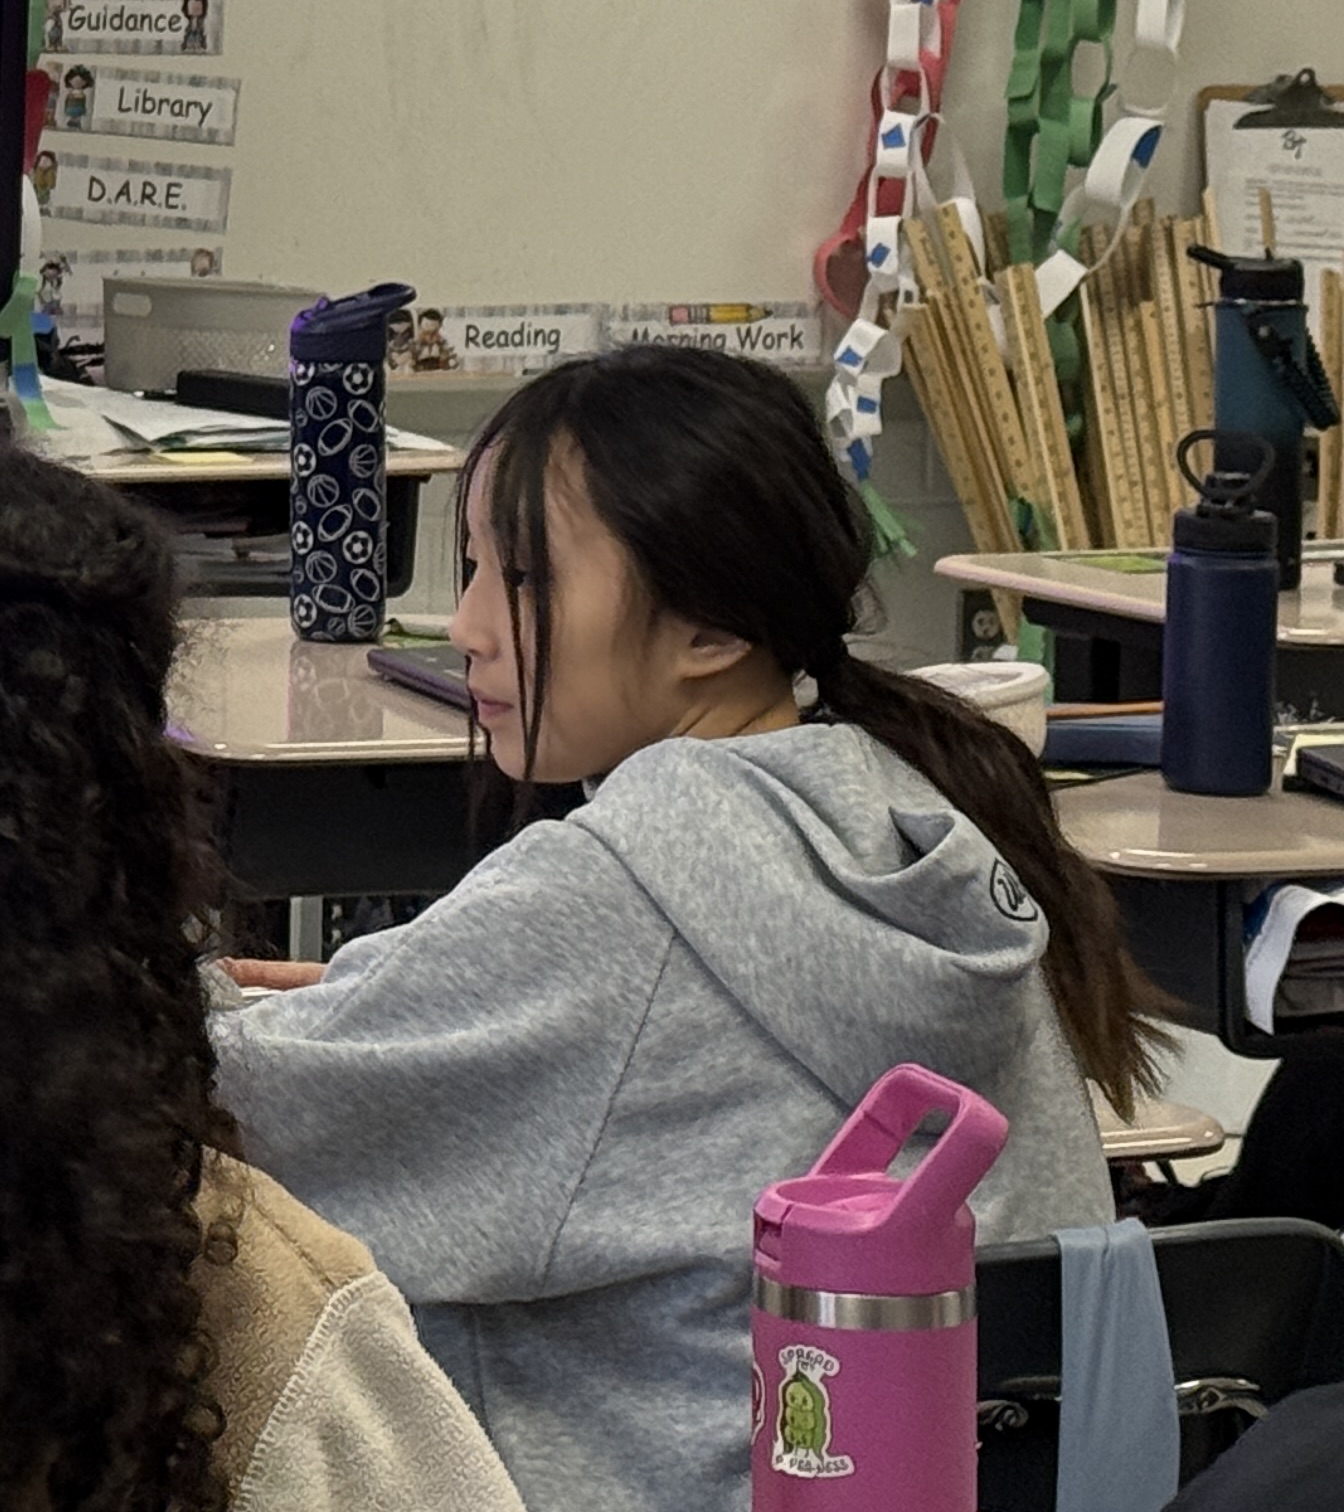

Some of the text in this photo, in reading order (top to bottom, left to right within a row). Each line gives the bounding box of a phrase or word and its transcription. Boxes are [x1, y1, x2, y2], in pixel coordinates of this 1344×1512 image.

[67, 3, 183, 34] Guidance
[117, 86, 214, 128] Library
[86, 174, 188, 212] D.A.R.E.
[464, 324, 562, 353] Reading
[734, 322, 805, 351] Work
